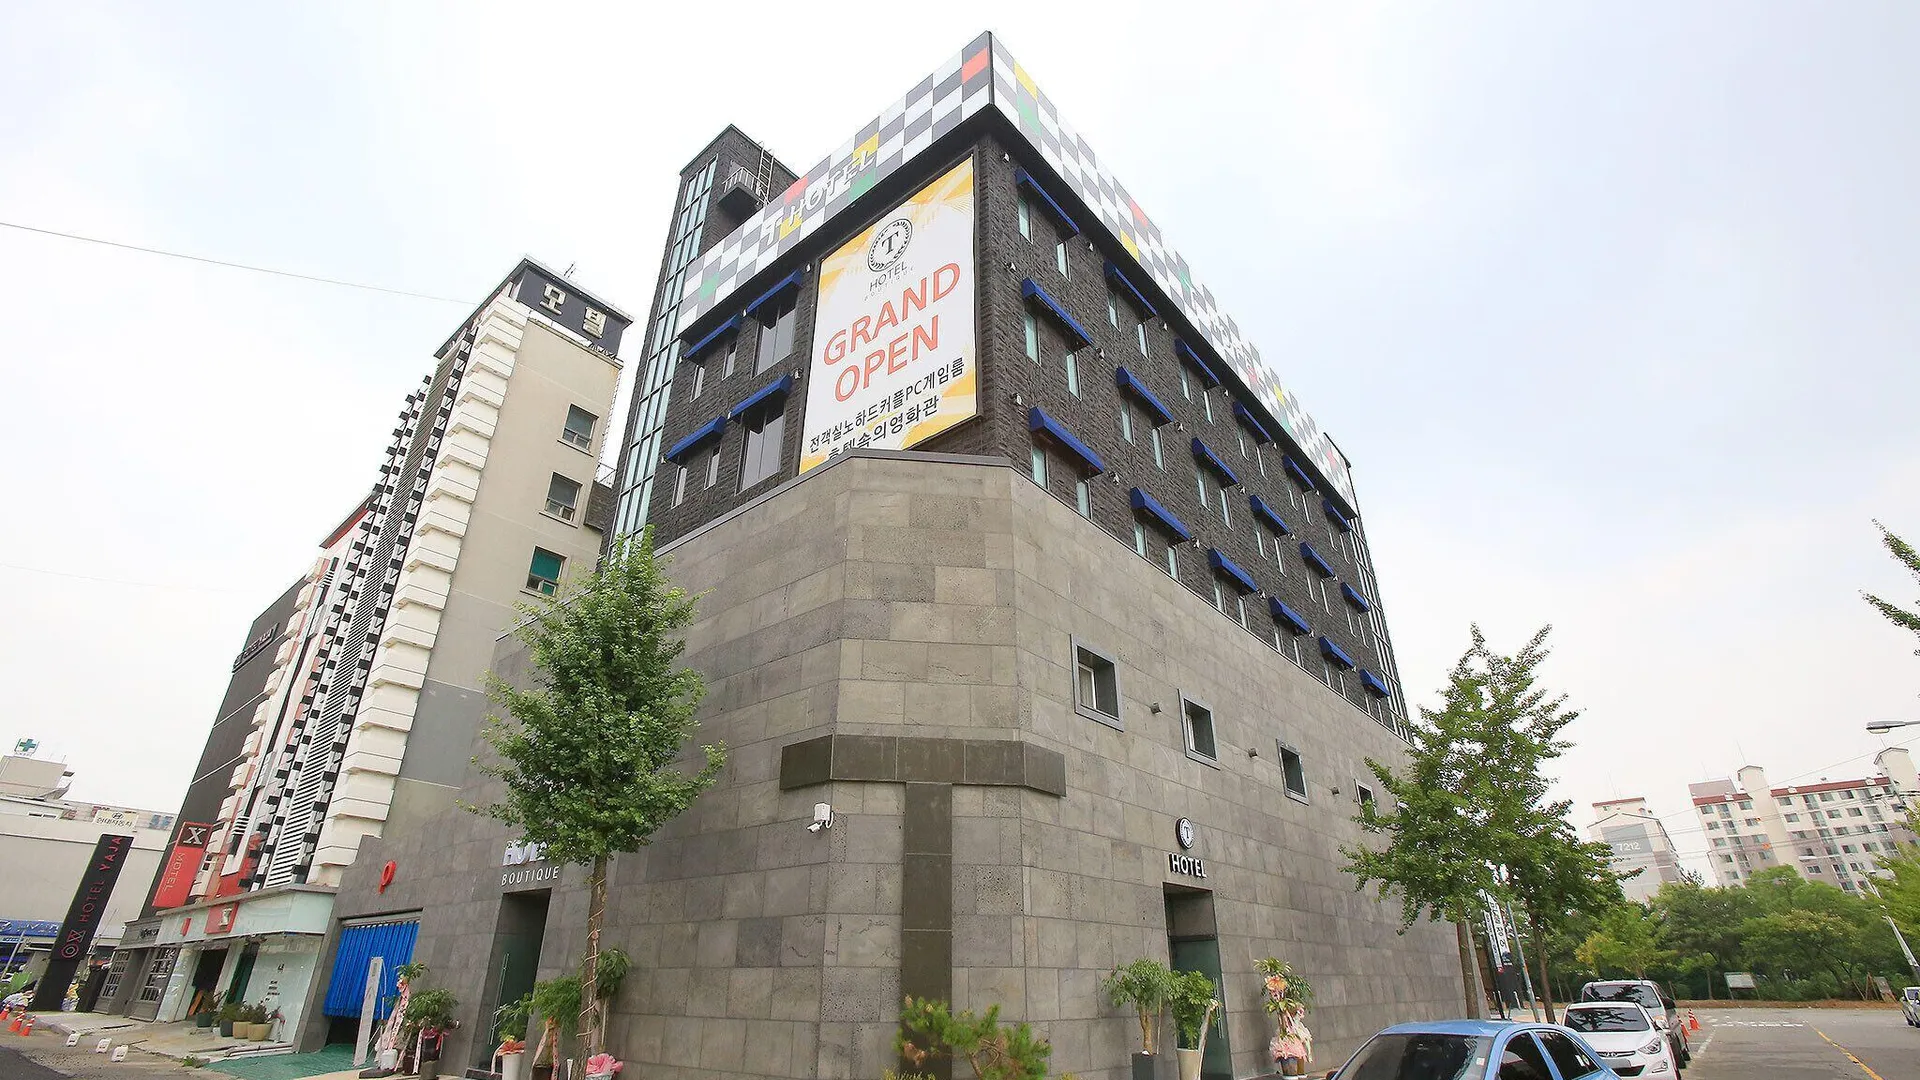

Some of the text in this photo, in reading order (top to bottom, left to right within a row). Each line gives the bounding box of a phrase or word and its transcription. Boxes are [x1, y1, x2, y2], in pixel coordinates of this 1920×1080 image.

[788, 150, 876, 228] HOTEL
[881, 231, 899, 255] T
[869, 261, 907, 292] HOTEL
[823, 262, 960, 365] GRAND
[834, 314, 939, 402] OPEN
[183, 827, 206, 845] X
[1616, 841, 1642, 852] 7212
[80, 880, 105, 922] HOTEL
[100, 837, 122, 871] YAJA
[163, 852, 186, 892] MOTEL
[501, 865, 560, 886] BOUTIQUE
[1169, 852, 1208, 878] HOTEL
